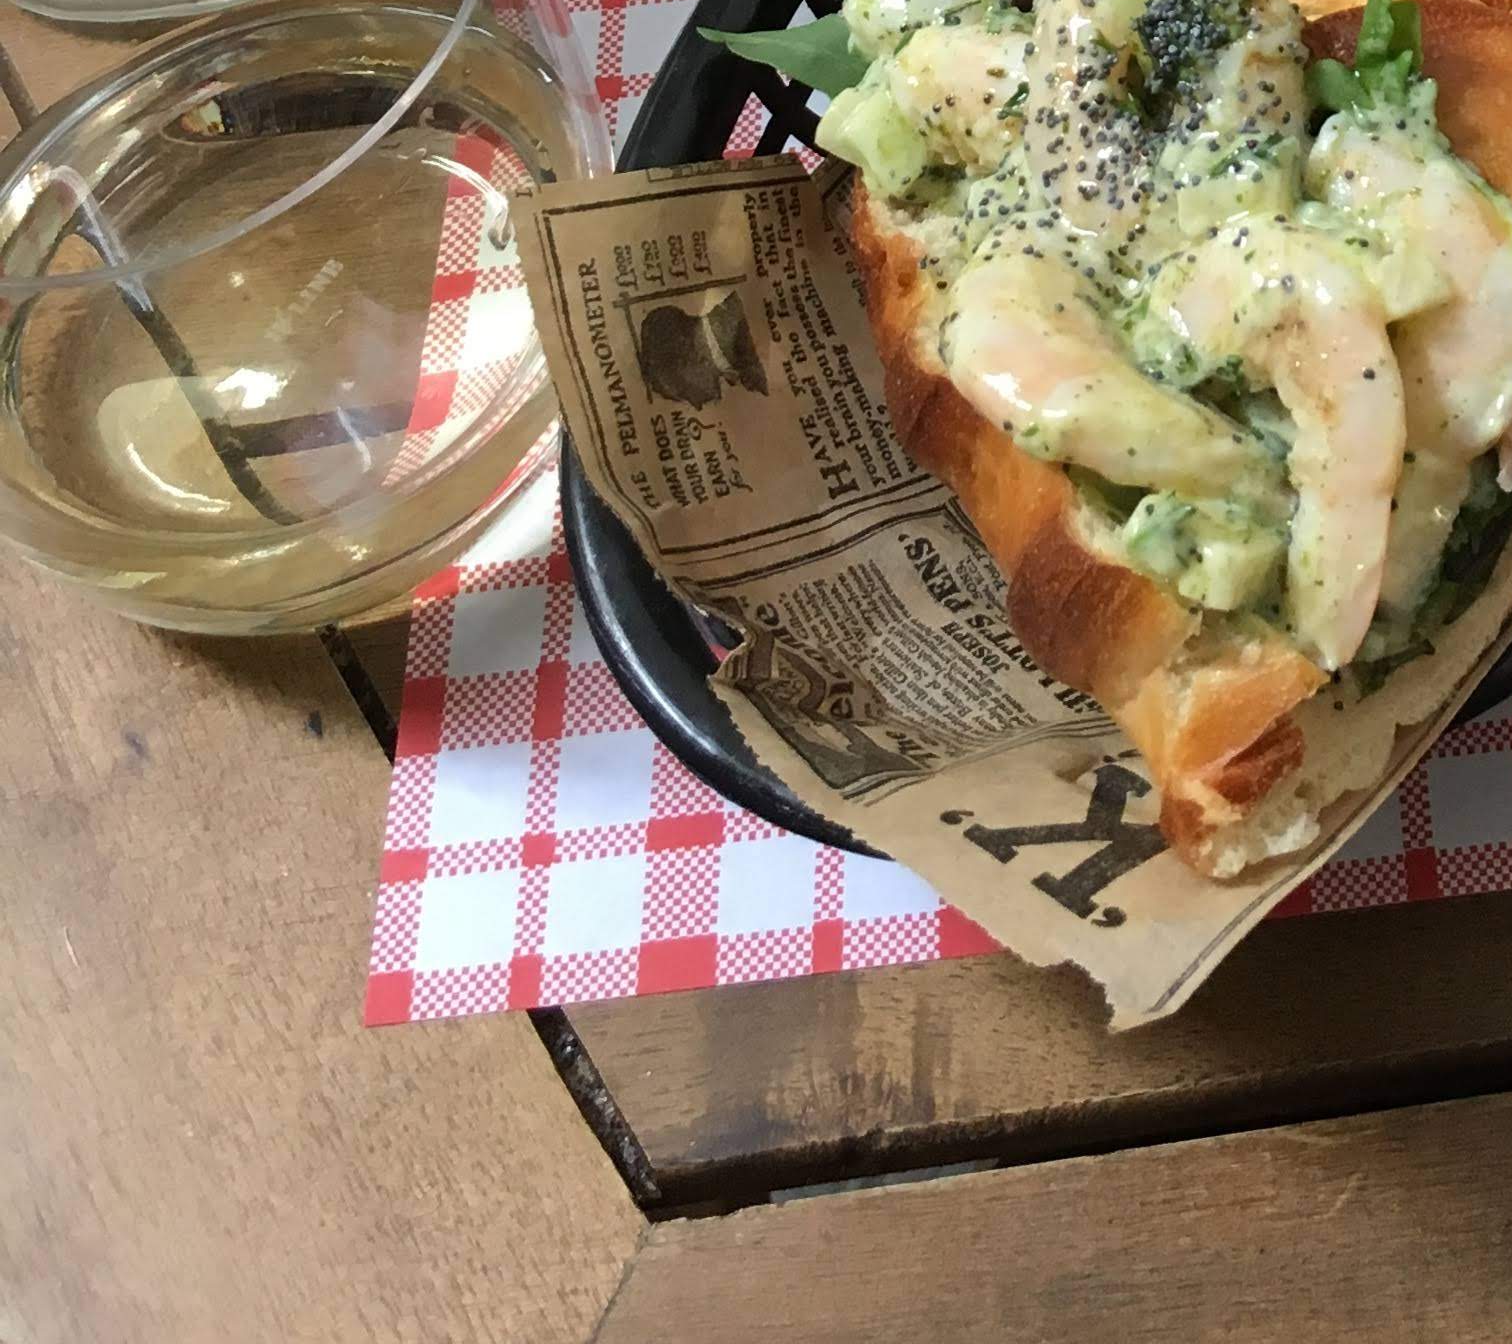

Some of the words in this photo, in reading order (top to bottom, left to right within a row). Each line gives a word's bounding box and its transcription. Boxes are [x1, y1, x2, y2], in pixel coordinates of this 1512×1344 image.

[757, 190, 770, 210] in
[771, 187, 792, 243] finest
[786, 185, 801, 217] the
[741, 191, 769, 278] properly
[761, 223, 779, 265] that
[781, 246, 797, 280] the
[760, 296, 783, 343] ever
[769, 279, 792, 318] fact
[788, 283, 825, 352] possess
[796, 257, 837, 338] machine
[576, 258, 639, 456] PELMANOMETER
[786, 330, 808, 363] the
[779, 359, 806, 397] you
[816, 353, 844, 389] you
[801, 374, 846, 449] realised
[830, 343, 902, 481] money-making
[830, 389, 862, 442] brain
[650, 413, 674, 461] DOES
[798, 413, 859, 500] HAVE
[661, 464, 690, 506] WHAT
[684, 462, 709, 504] YOUR
[702, 449, 730, 497] EARN
[726, 467, 753, 495] for
[851, 441, 886, 487] your
[630, 470, 660, 510] THE
[833, 640, 858, 662] pen
[940, 618, 1011, 678] JOSEPH
[904, 679, 928, 701] than
[884, 724, 942, 770] The
